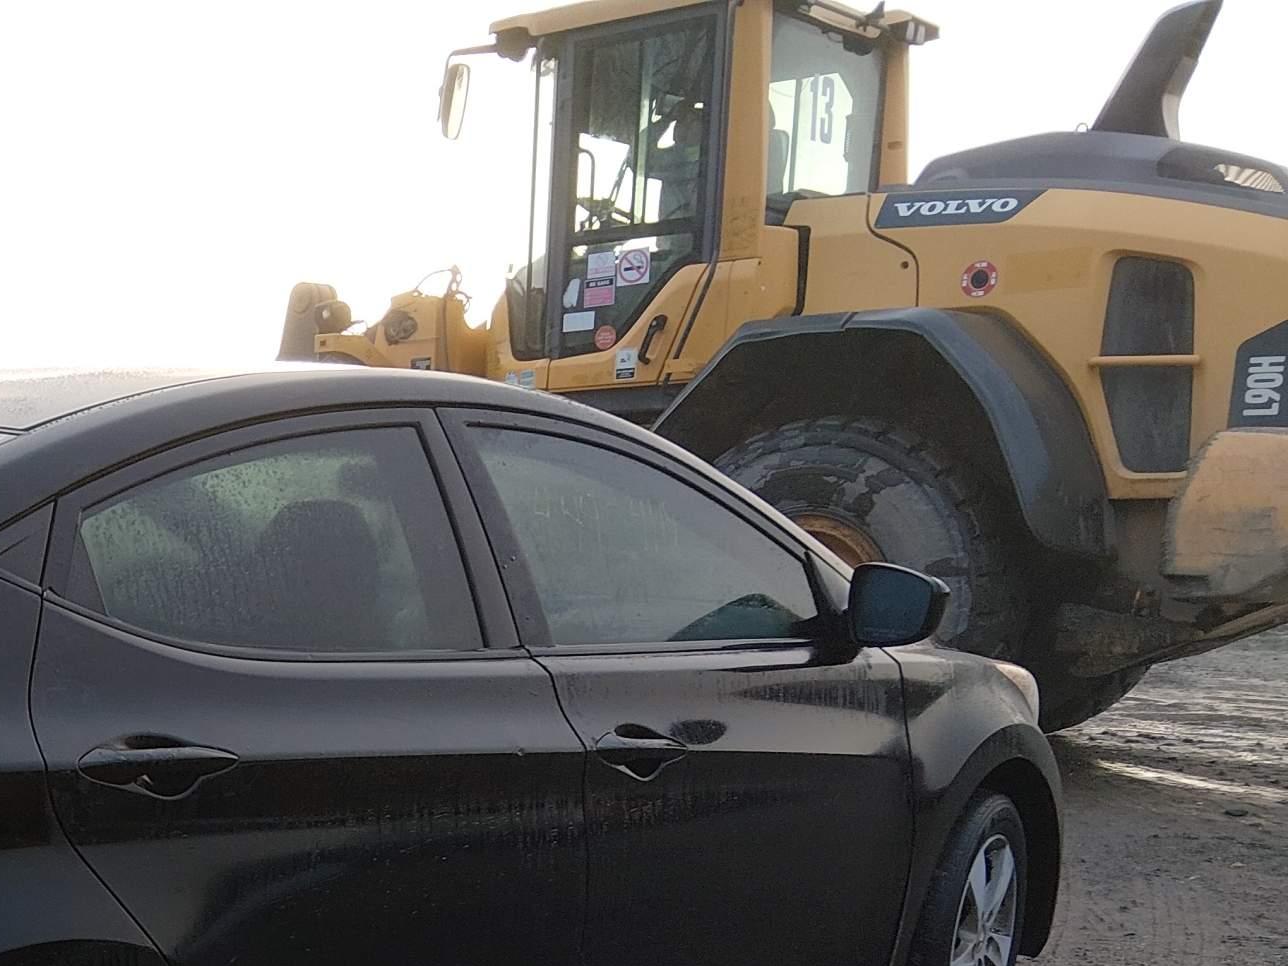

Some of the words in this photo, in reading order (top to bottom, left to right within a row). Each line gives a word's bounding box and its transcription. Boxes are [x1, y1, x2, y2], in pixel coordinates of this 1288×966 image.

[810, 74, 835, 145] 13
[893, 197, 1019, 217] VOLVO
[1242, 355, 1287, 417] L90H
